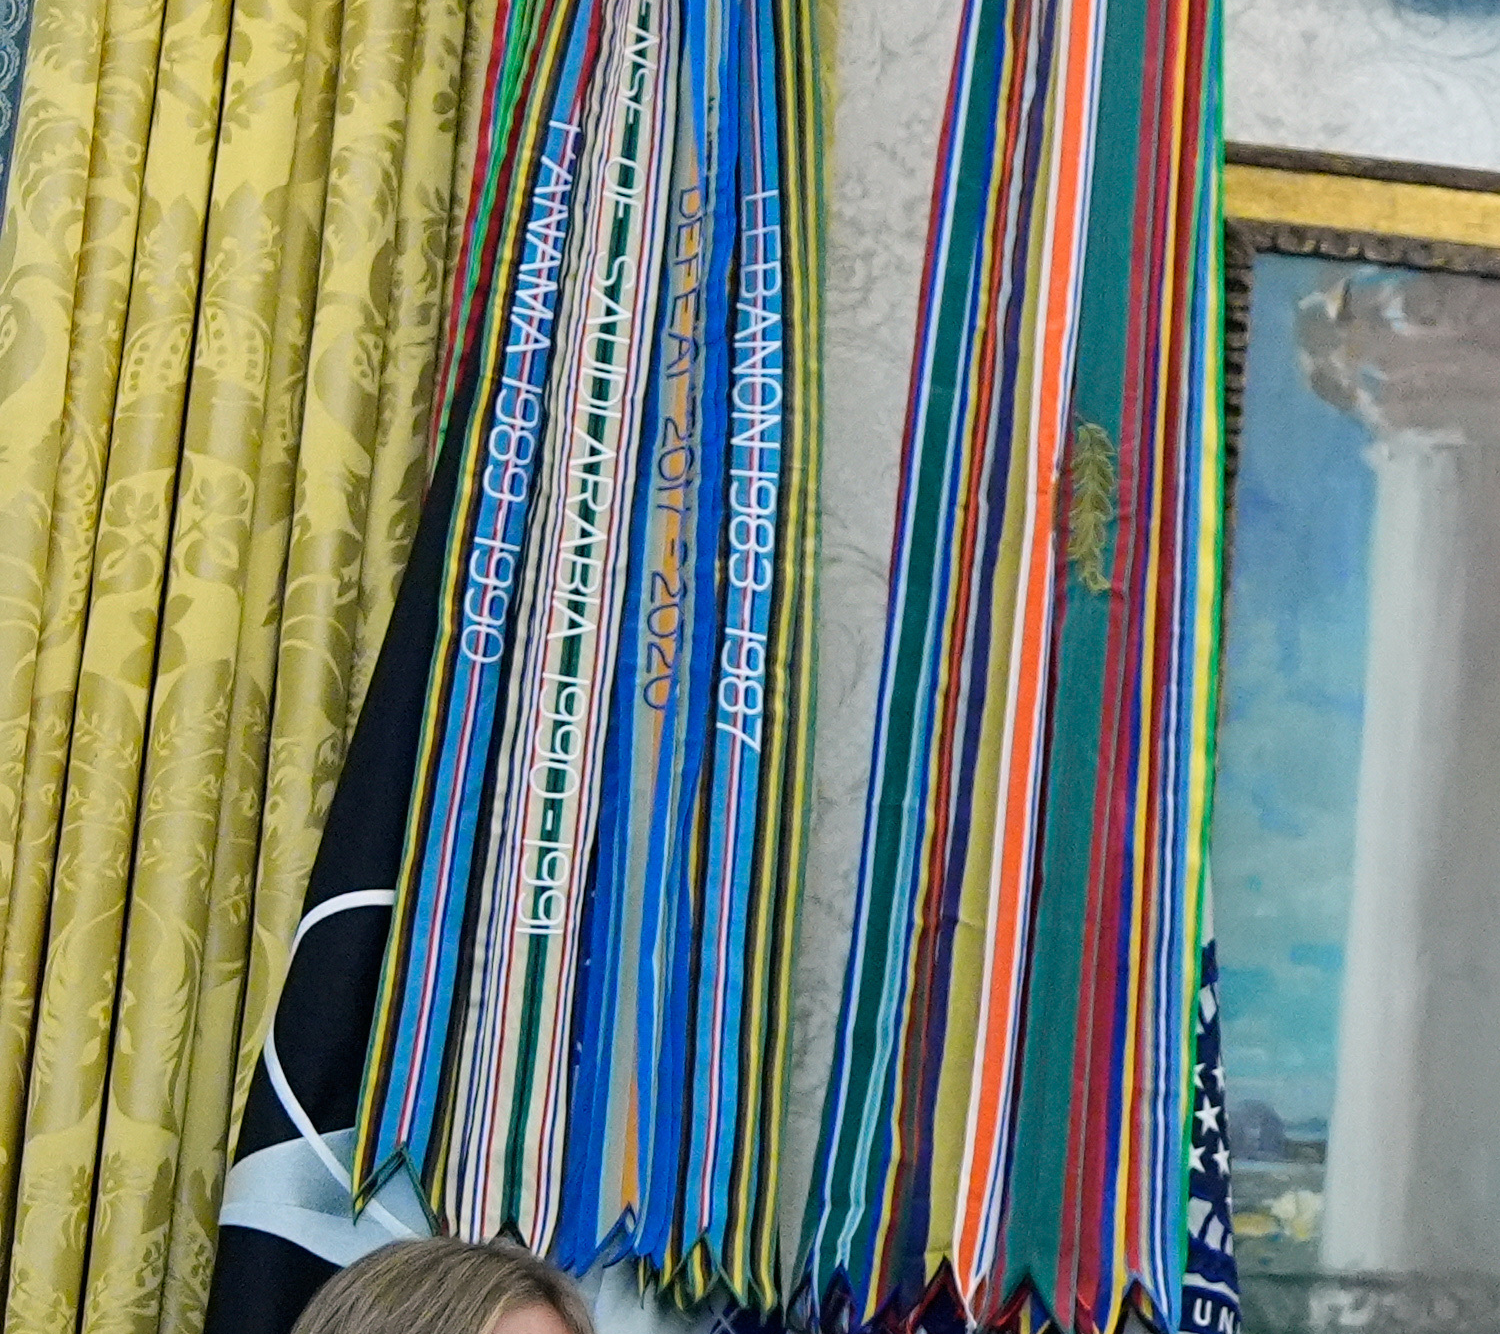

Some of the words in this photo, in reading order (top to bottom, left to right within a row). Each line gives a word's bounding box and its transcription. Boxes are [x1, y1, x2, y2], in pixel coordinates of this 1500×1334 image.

[506, 119, 582, 353] PANAMA
[602, 155, 645, 234] OF
[576, 250, 637, 418] SAUDI
[730, 188, 783, 450] LEBANON
[547, 426, 617, 640] ARABIA
[515, 671, 590, 935] 1990-1991
